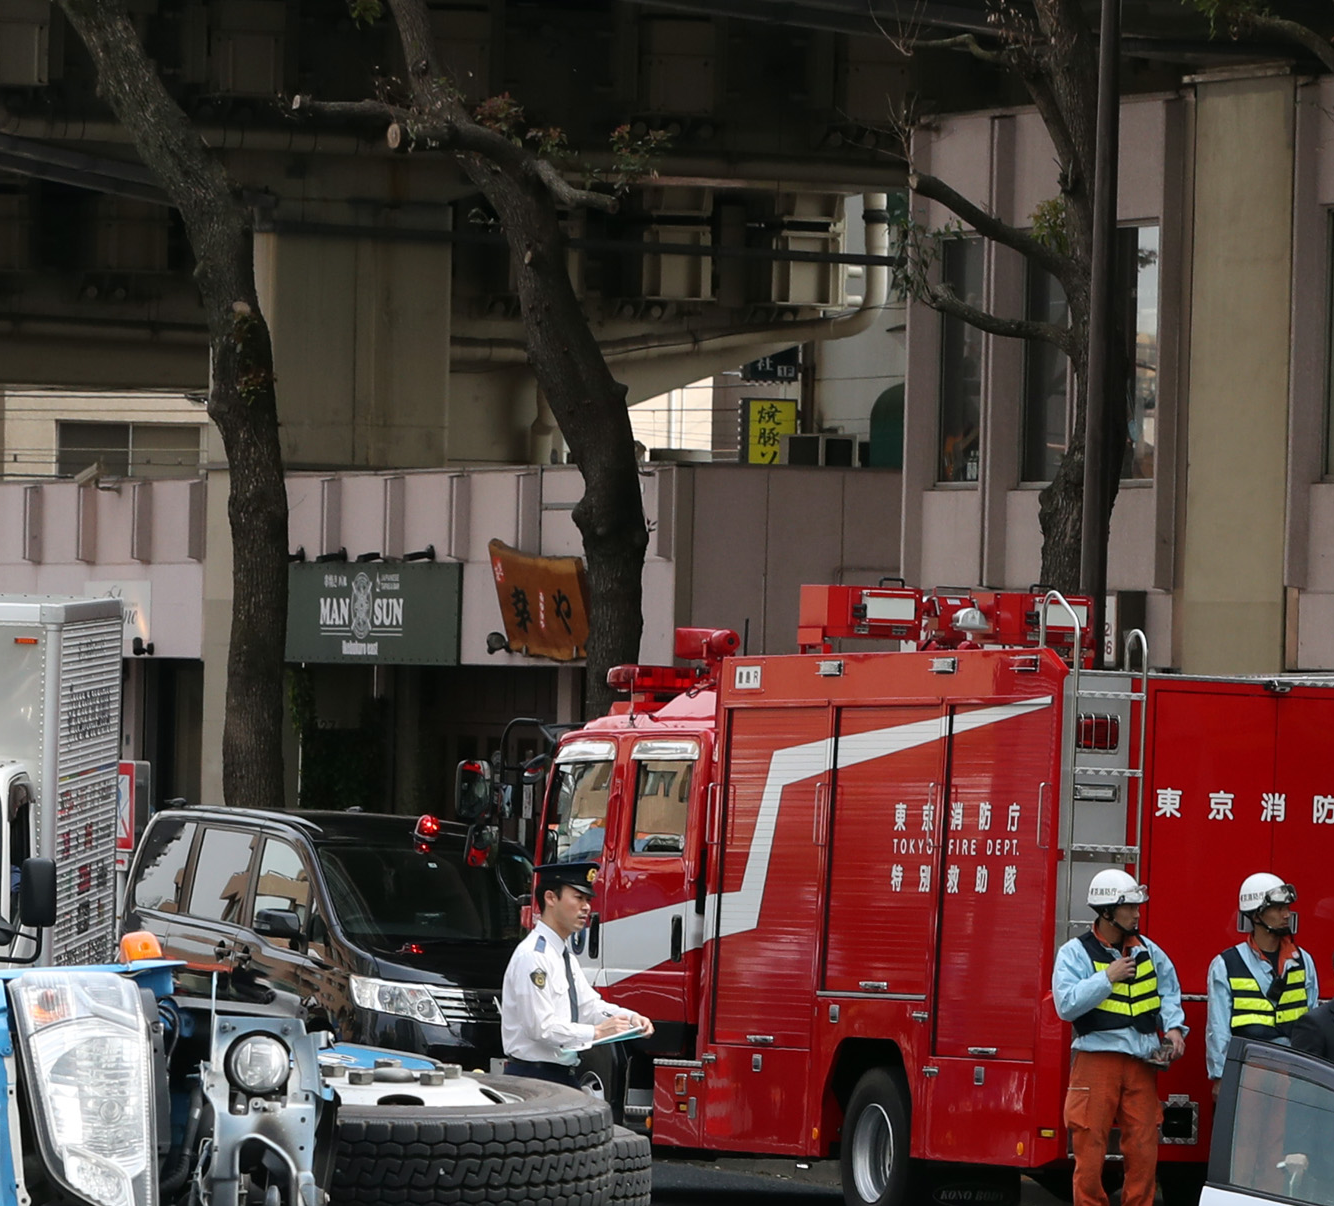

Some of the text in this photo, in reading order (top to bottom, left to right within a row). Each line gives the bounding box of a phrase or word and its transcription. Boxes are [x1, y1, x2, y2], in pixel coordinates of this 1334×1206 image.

[319, 597, 404, 626] MAN SUN
[893, 802, 1021, 832] 東京消防庁
[893, 838, 1020, 856] TOKYO FIRE DEPT.
[890, 863, 1017, 895] 特別救助隊
